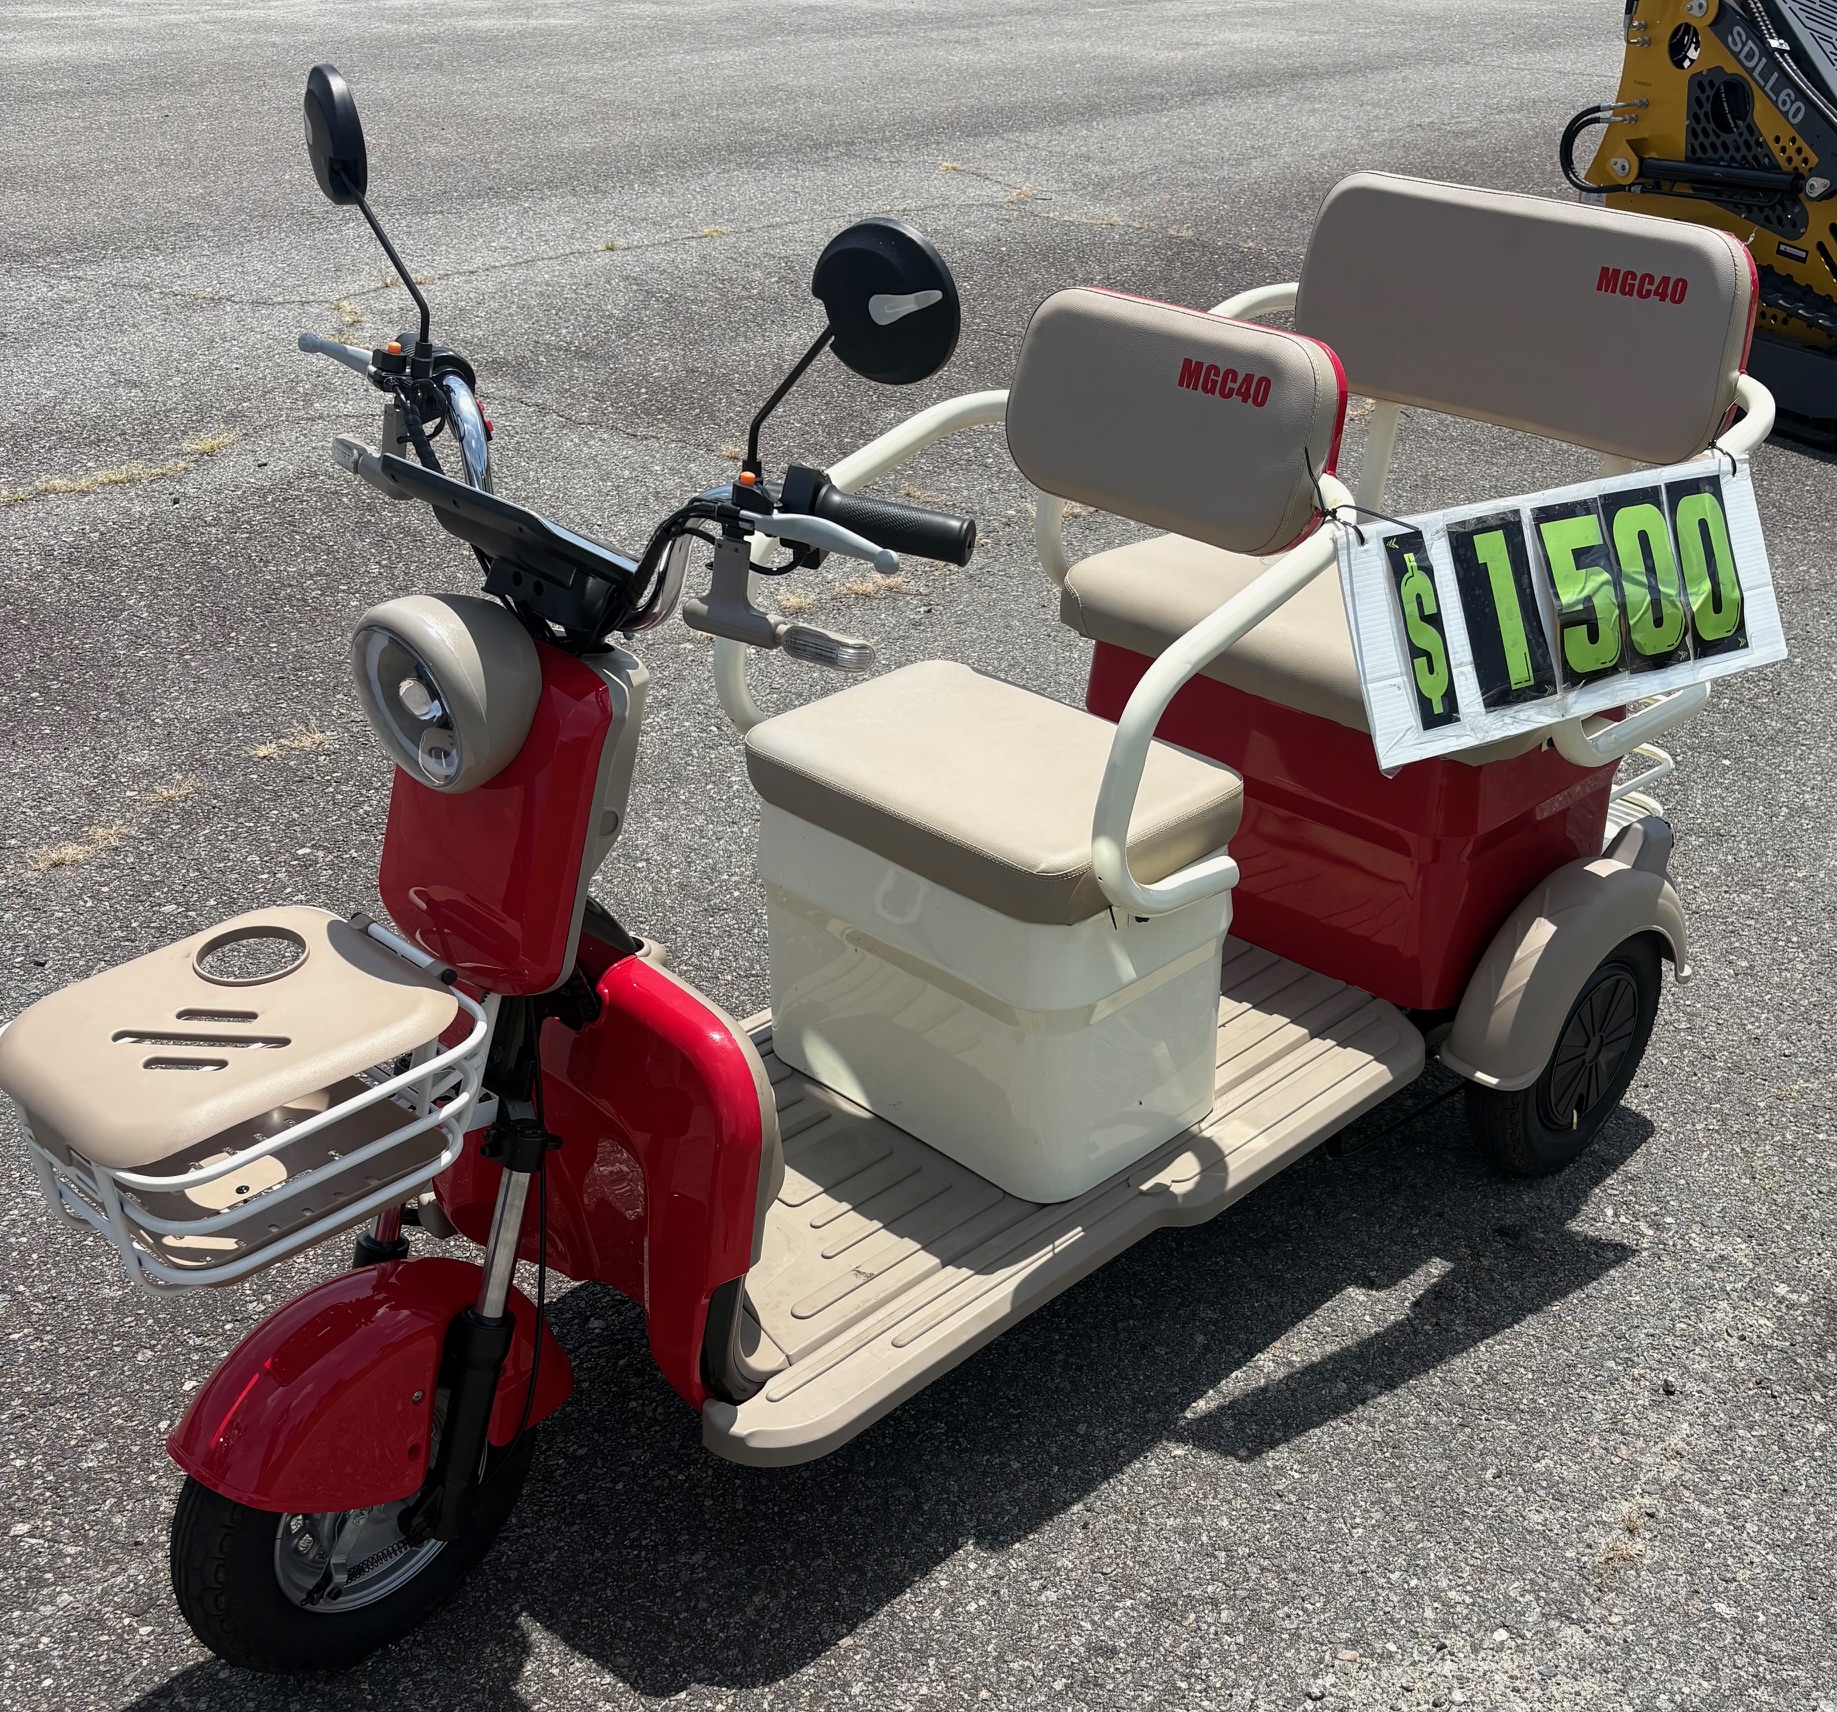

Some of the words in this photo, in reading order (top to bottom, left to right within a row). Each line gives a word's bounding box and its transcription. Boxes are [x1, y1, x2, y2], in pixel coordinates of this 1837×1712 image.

[1727, 25, 1806, 125] SDLL60
[1596, 266, 1688, 305] MGC40
[1177, 357, 1272, 408] MGC40
